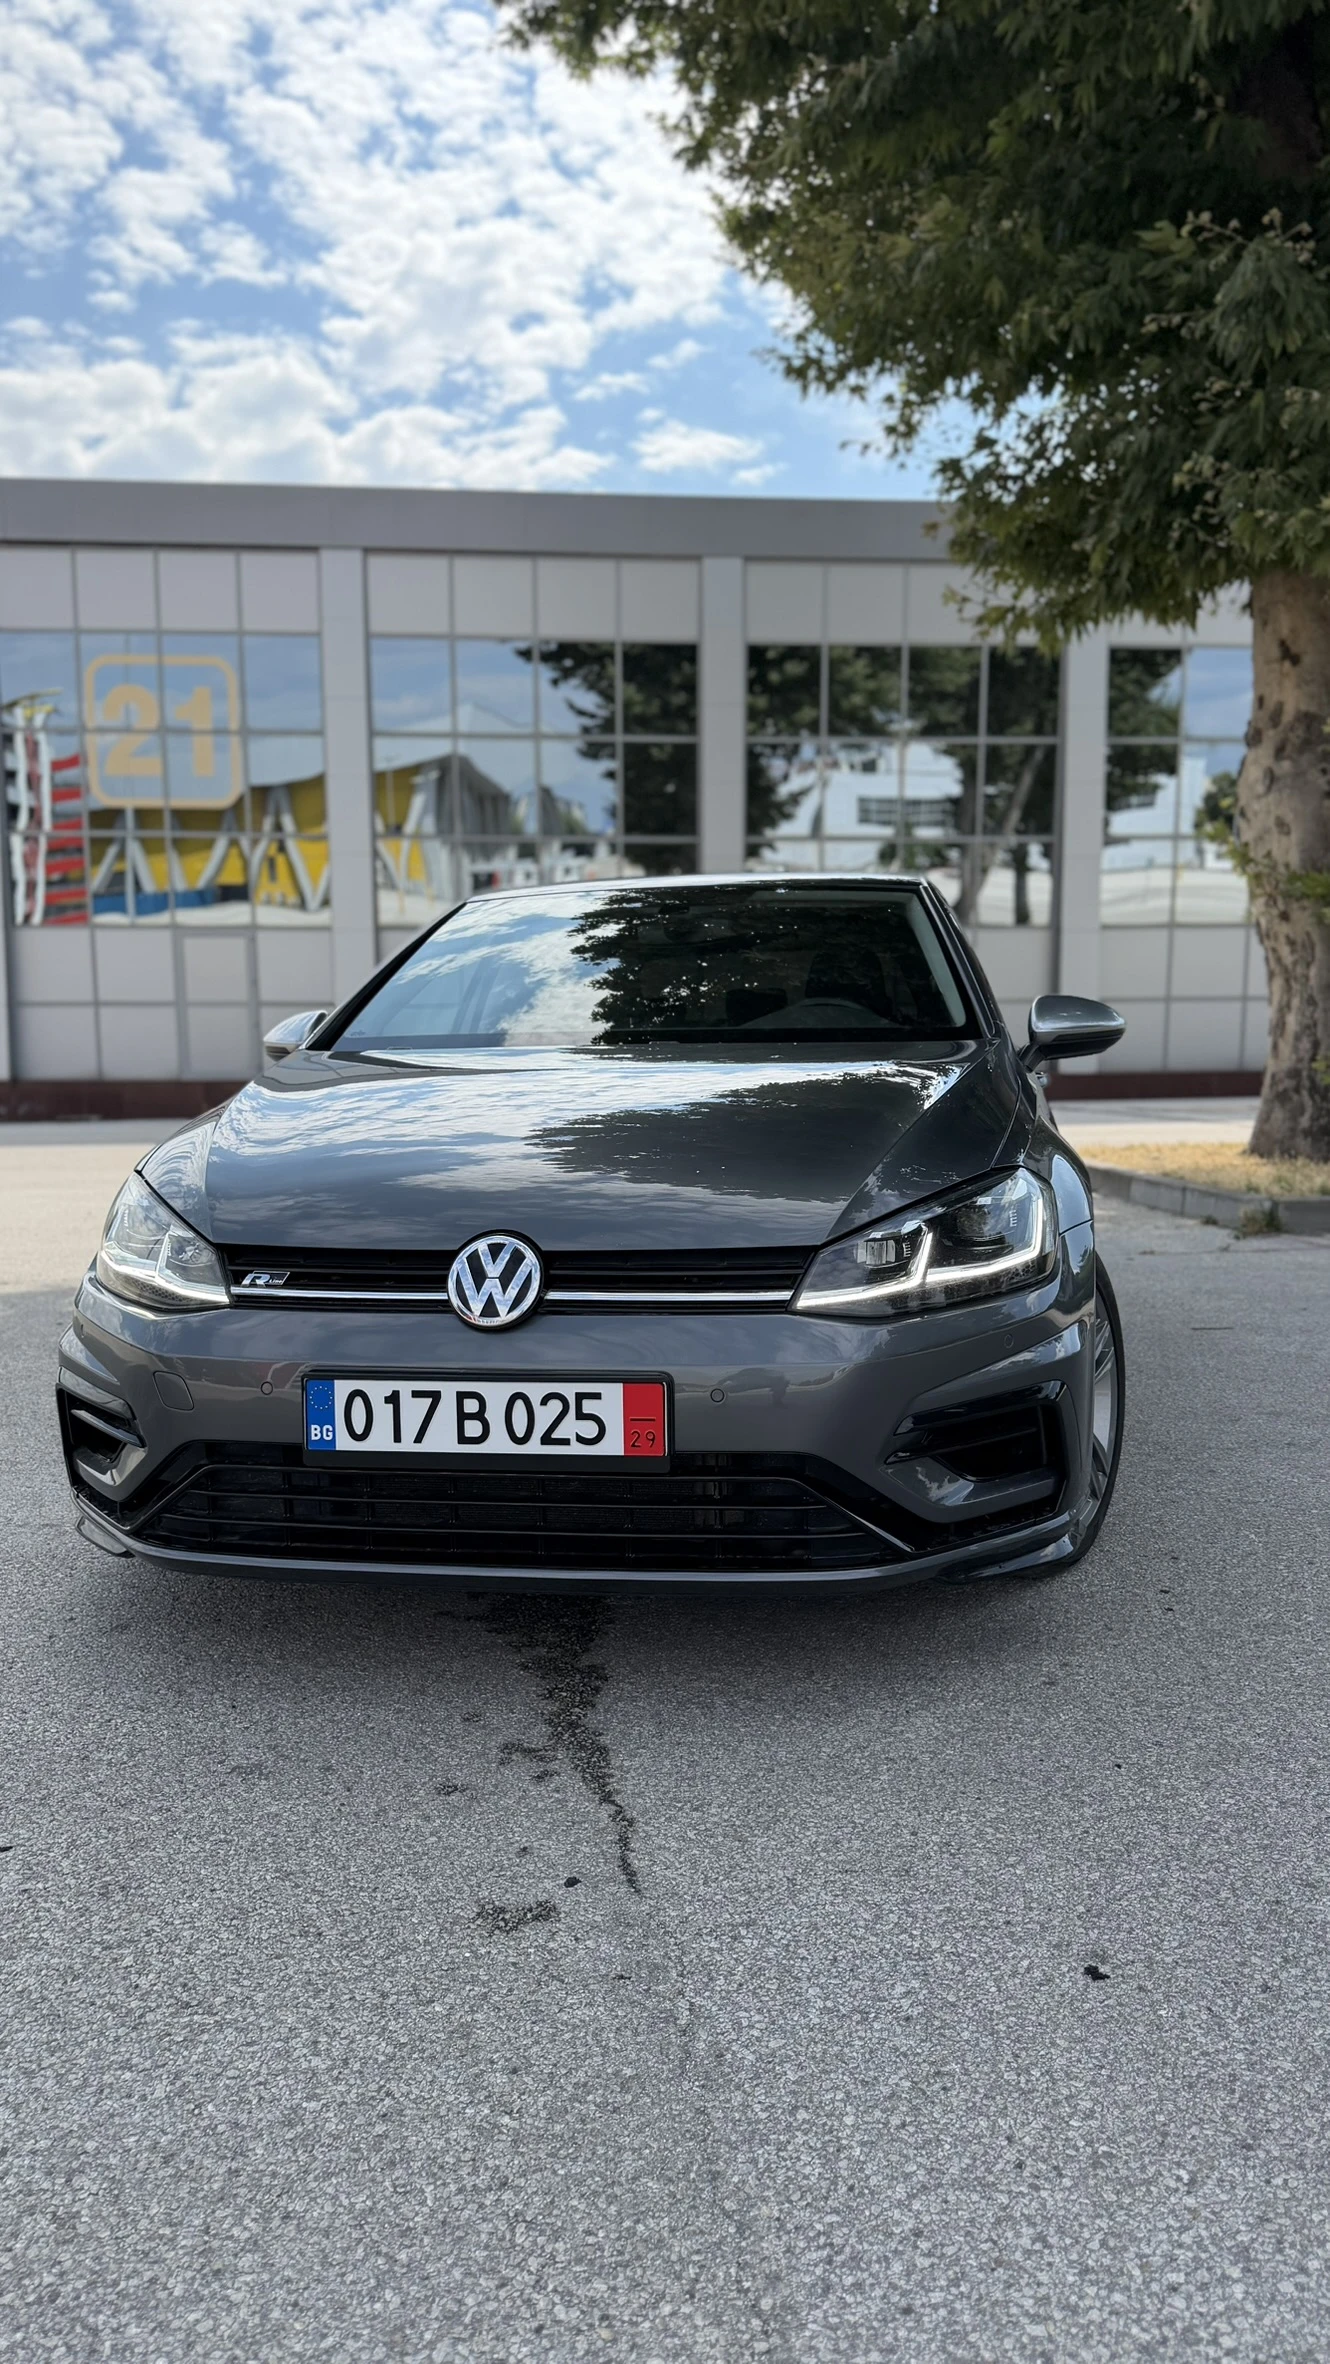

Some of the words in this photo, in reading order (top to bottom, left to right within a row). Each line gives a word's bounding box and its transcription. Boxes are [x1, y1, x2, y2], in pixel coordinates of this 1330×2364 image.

[103, 684, 216, 777] 21
[456, 1242, 533, 1317] VW
[311, 1424, 333, 1441] BG
[630, 1430, 656, 1448] 29
